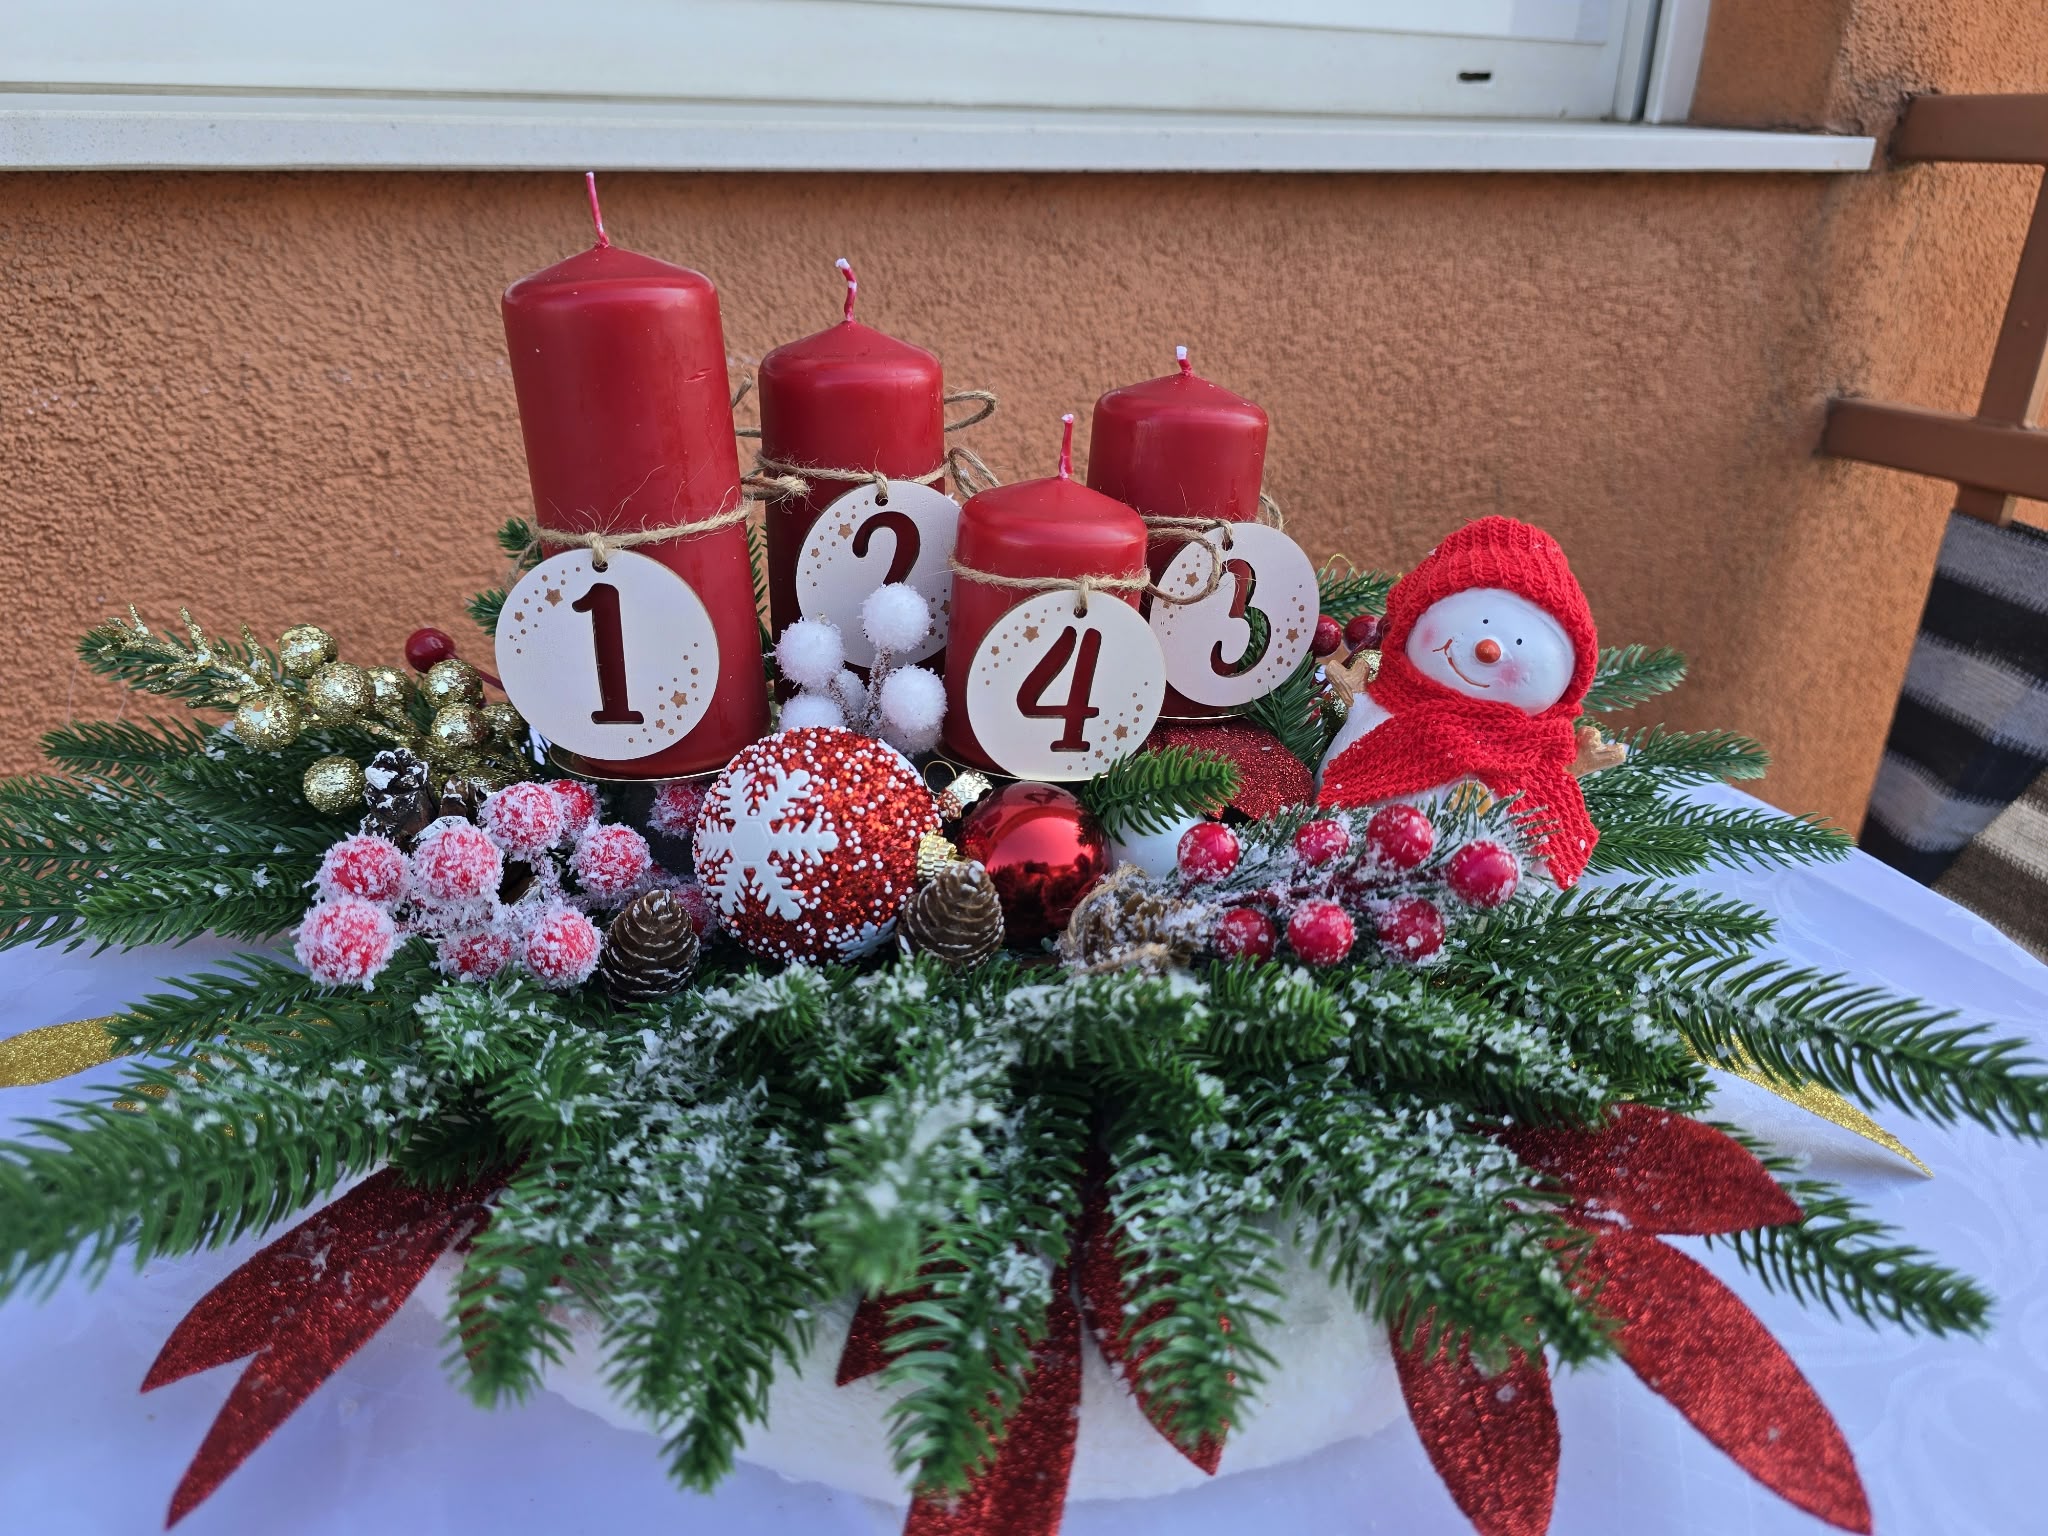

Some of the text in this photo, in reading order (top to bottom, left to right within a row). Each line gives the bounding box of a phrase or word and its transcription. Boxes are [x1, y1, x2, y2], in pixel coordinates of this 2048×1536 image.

[572, 583, 644, 724] 1
[1211, 558, 1271, 678] 3
[1016, 626, 1102, 752] 4
